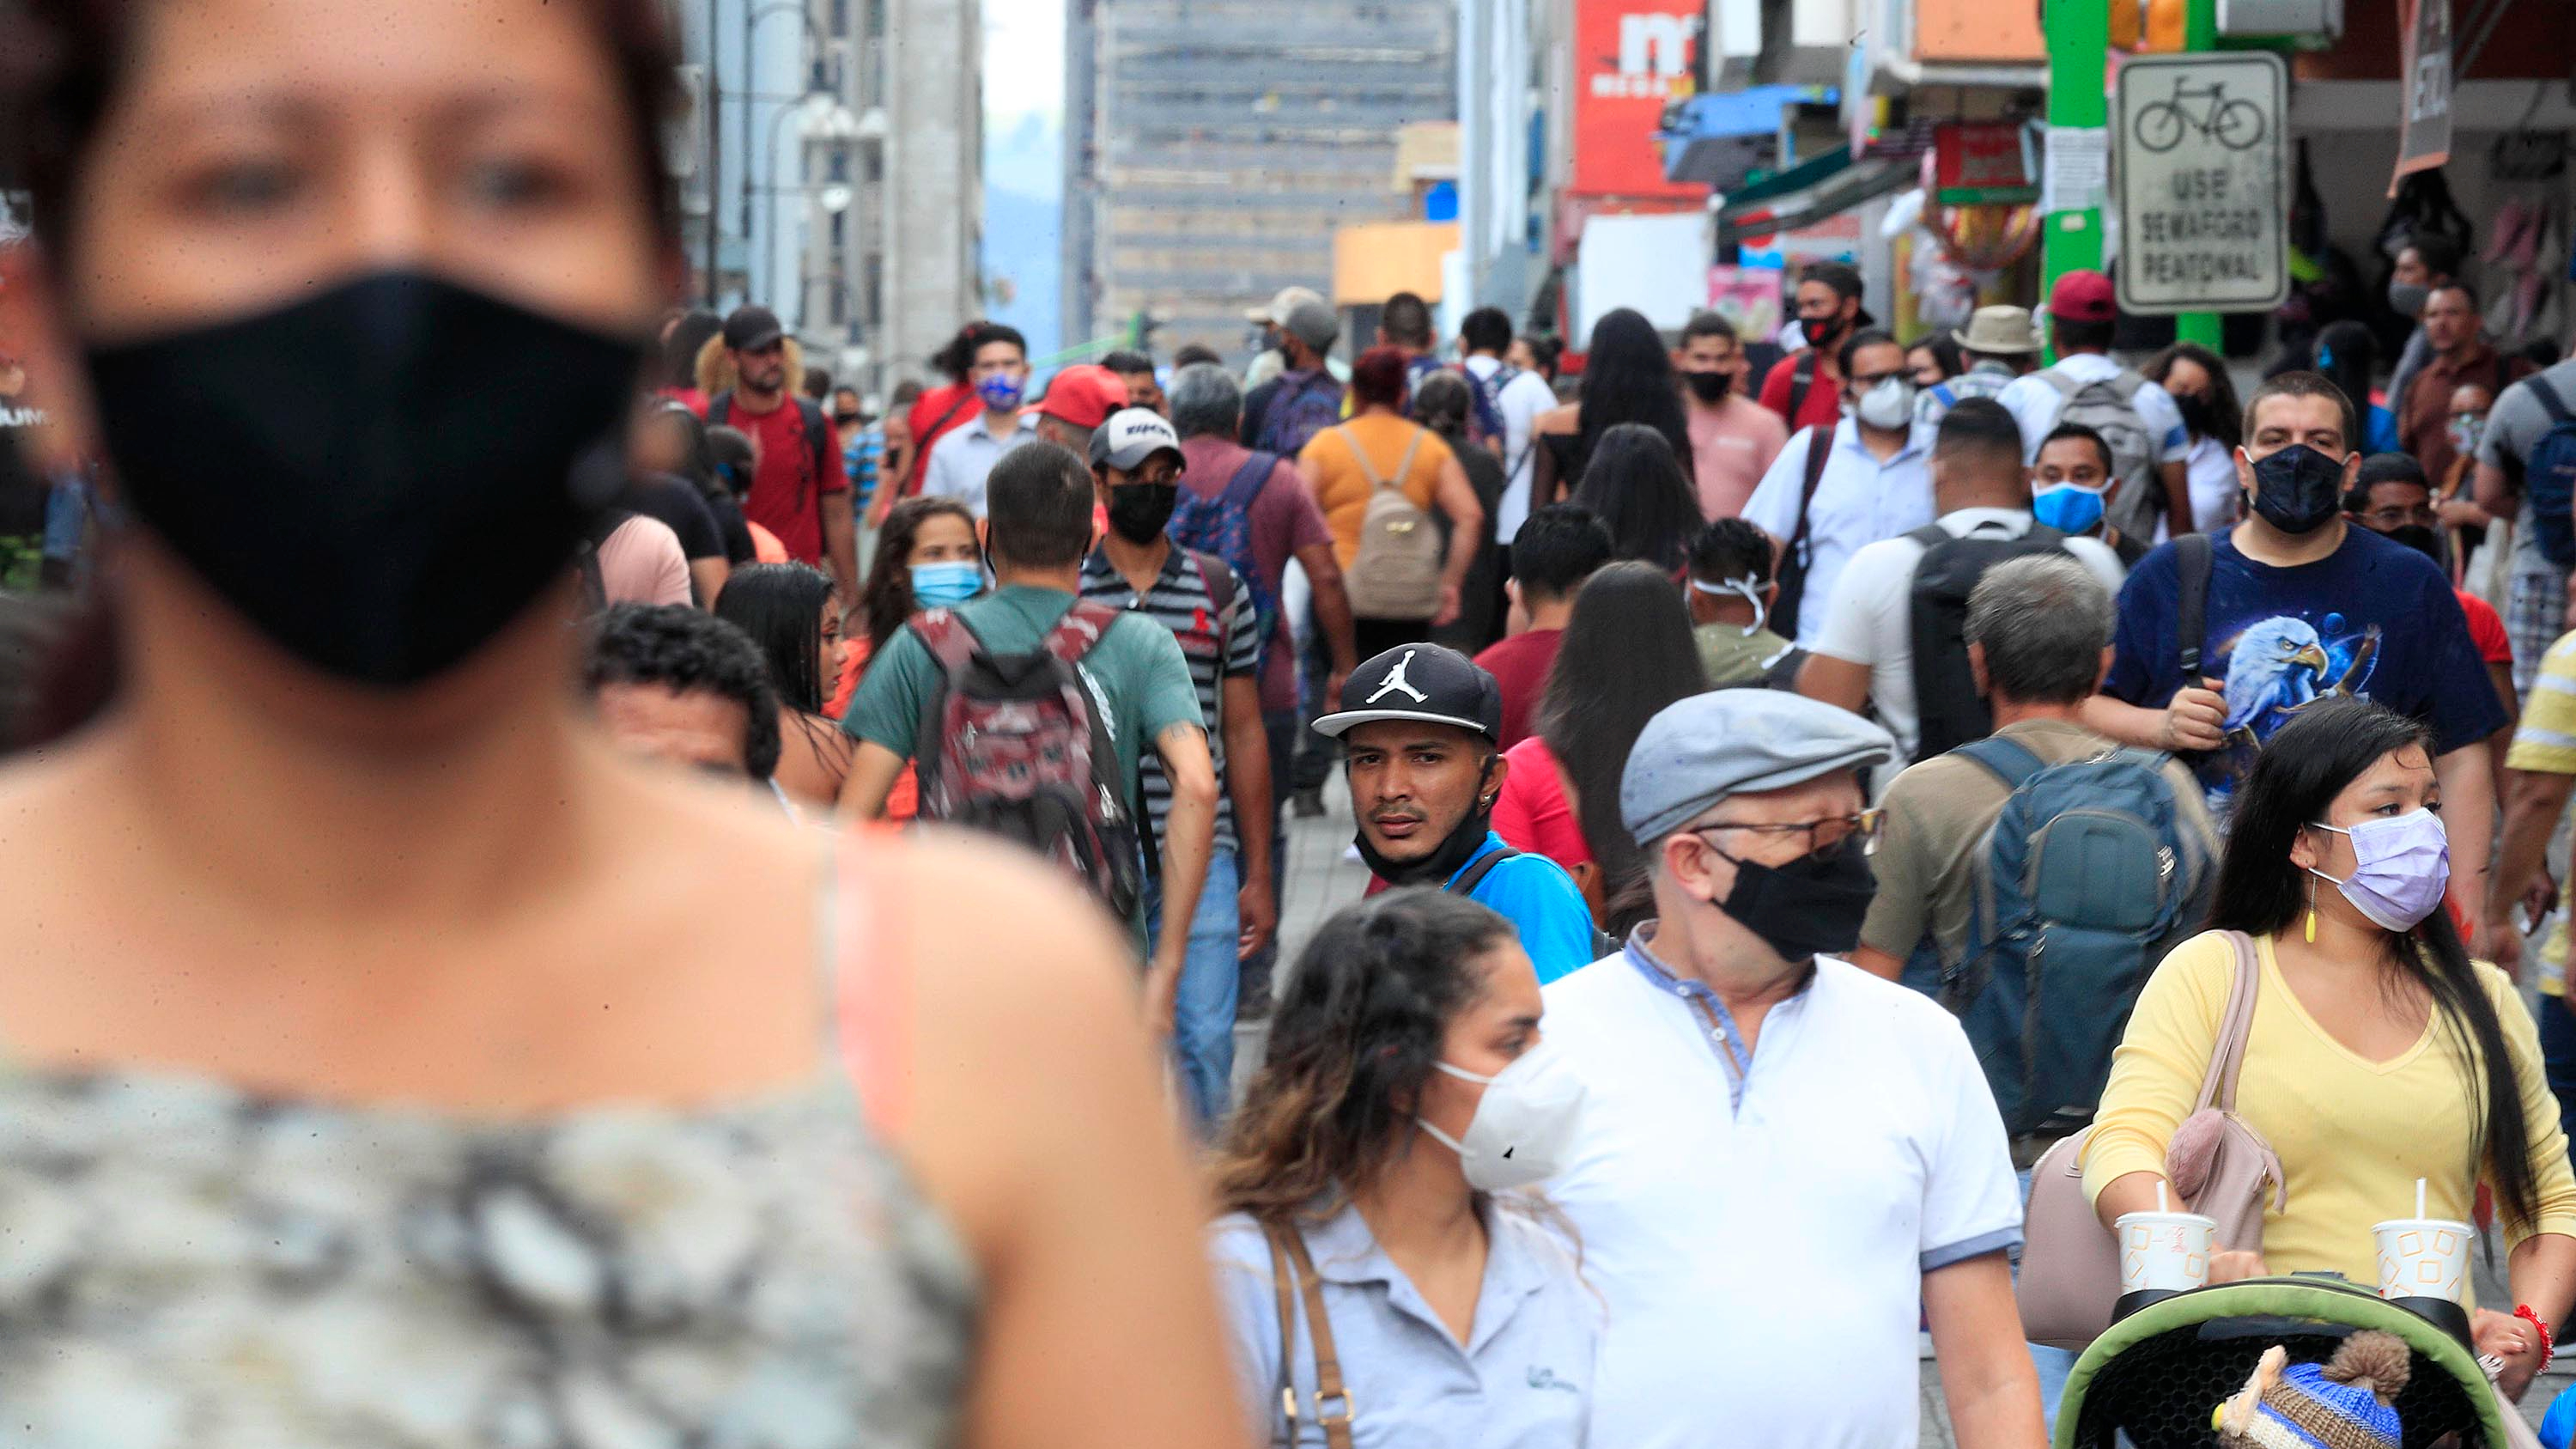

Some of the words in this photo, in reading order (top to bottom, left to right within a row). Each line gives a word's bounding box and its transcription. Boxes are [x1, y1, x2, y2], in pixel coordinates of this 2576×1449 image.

[2172, 167, 2230, 200] USE
[2142, 210, 2262, 242] SEMAFORO
[2143, 252, 2260, 283] PEATONAL
